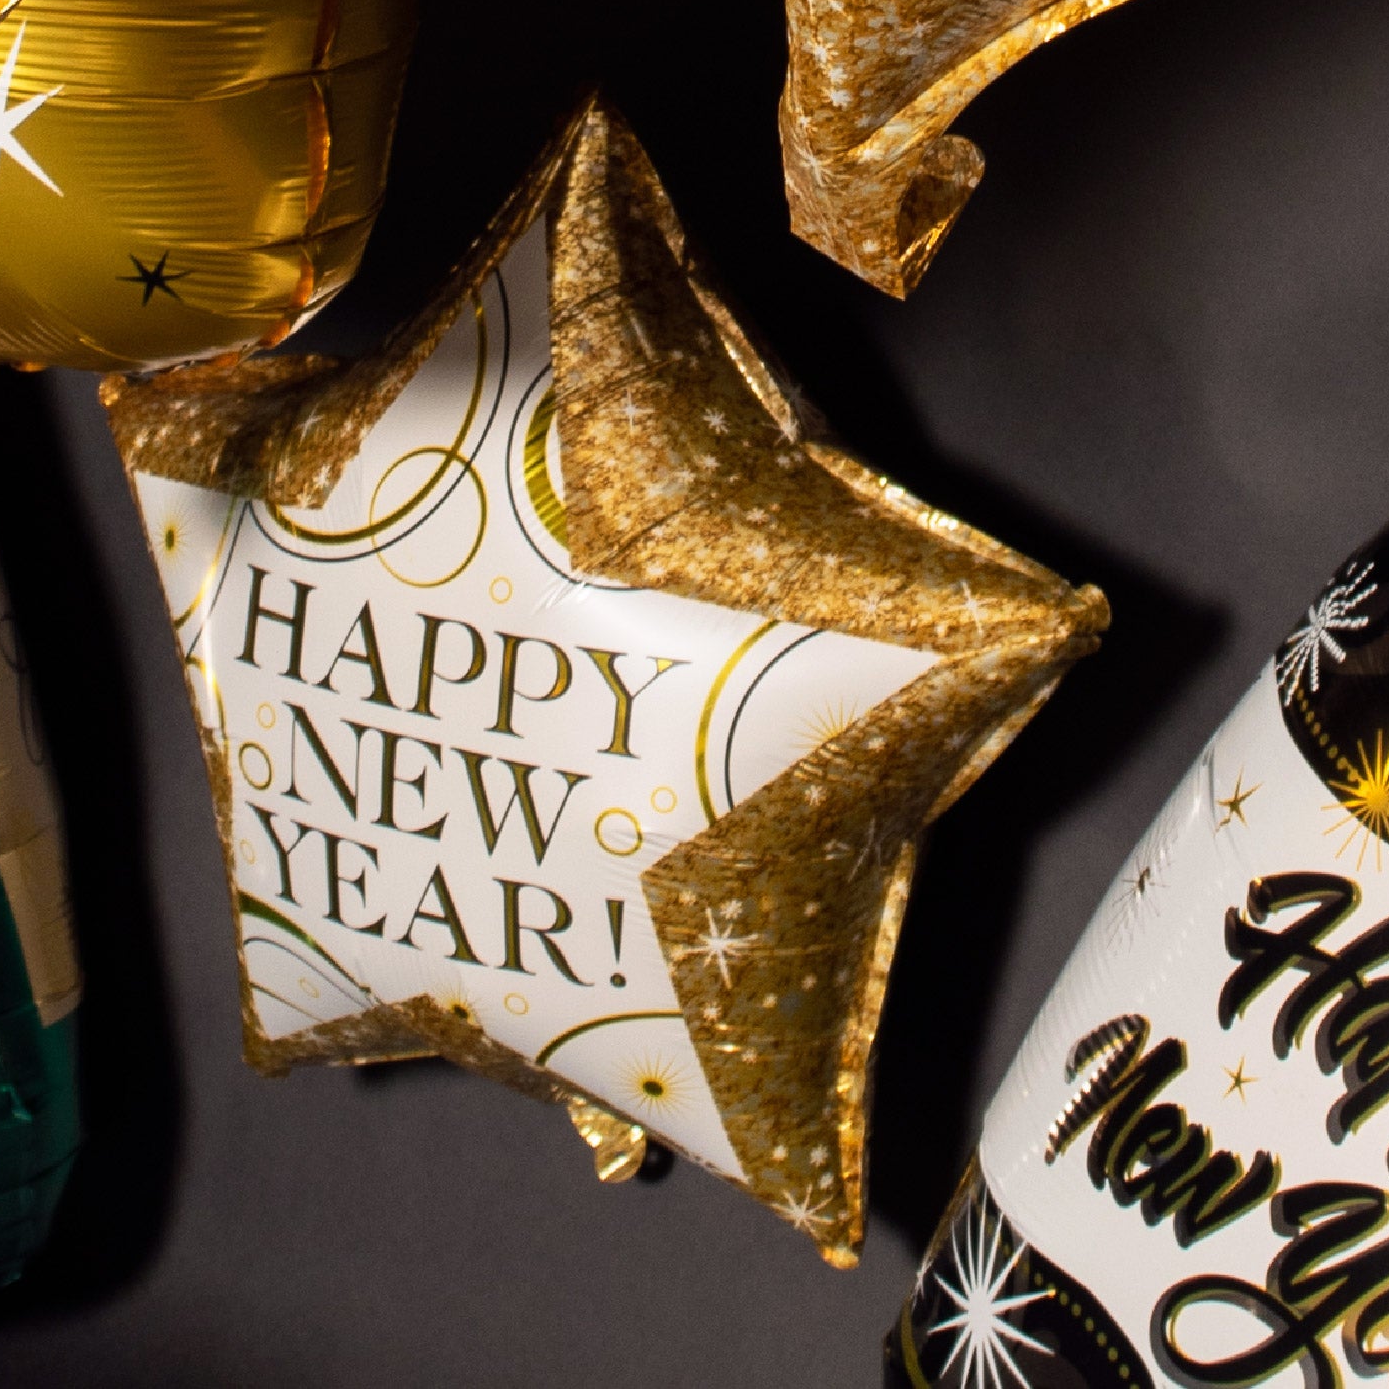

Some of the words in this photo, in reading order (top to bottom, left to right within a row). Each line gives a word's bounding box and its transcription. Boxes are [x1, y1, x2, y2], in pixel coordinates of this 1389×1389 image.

[235, 564, 692, 760] HAPPY
[281, 700, 592, 867] NEW
[244, 801, 627, 990] YEAR!
[1044, 1013, 1282, 1250] New
